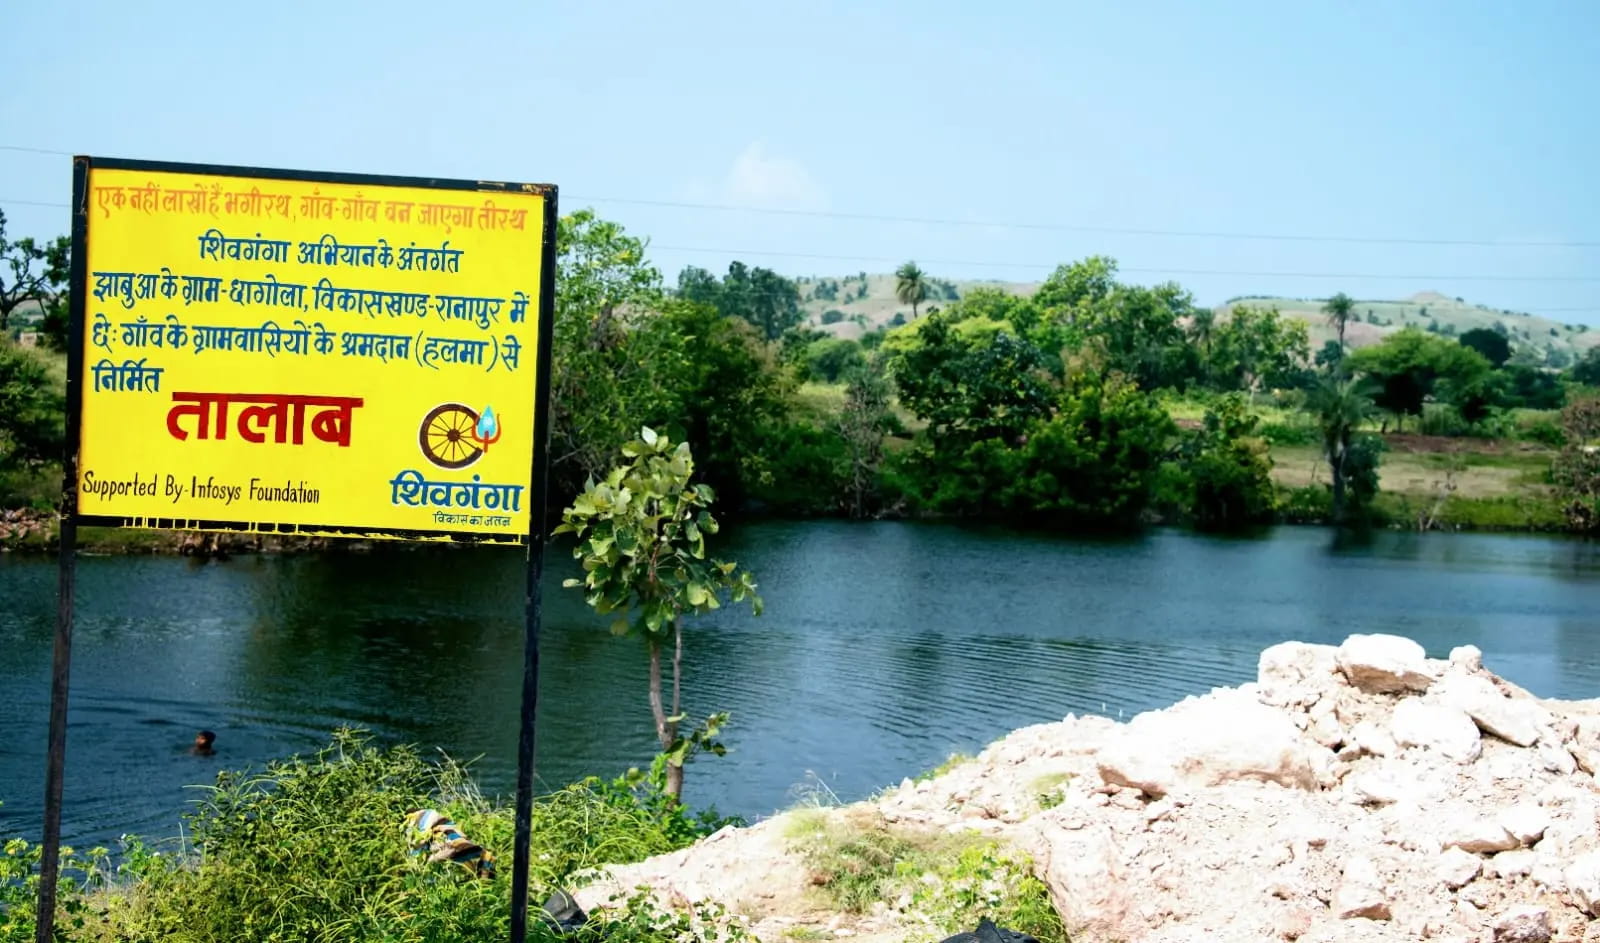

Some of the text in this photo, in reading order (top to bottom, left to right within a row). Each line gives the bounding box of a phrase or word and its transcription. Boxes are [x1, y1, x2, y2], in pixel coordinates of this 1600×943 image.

[95, 186, 126, 219] एक
[128, 182, 160, 216] नहीं
[418, 203, 475, 234] जाएगा
[478, 200, 528, 232] तीरथ
[198, 229, 464, 273] शिवगंगा अभियान के अंतर्गत
[92, 271, 161, 310] झाबुआ
[161, 267, 178, 300] के
[510, 291, 530, 323] में
[120, 315, 166, 349] गाँव
[166, 314, 188, 349] के
[192, 320, 312, 358] ग्रामवासियों
[313, 322, 336, 355] के
[341, 331, 412, 364] श्रमदान
[415, 330, 498, 372] (हलमा)
[500, 334, 521, 372] से
[91, 357, 164, 394] निर्मित
[167, 391, 364, 447] तालाब
[82, 470, 158, 502] Supported
[249, 477, 320, 504] Foundation
[389, 469, 525, 512] शिवगंगा
[432, 510, 469, 525] विकास
